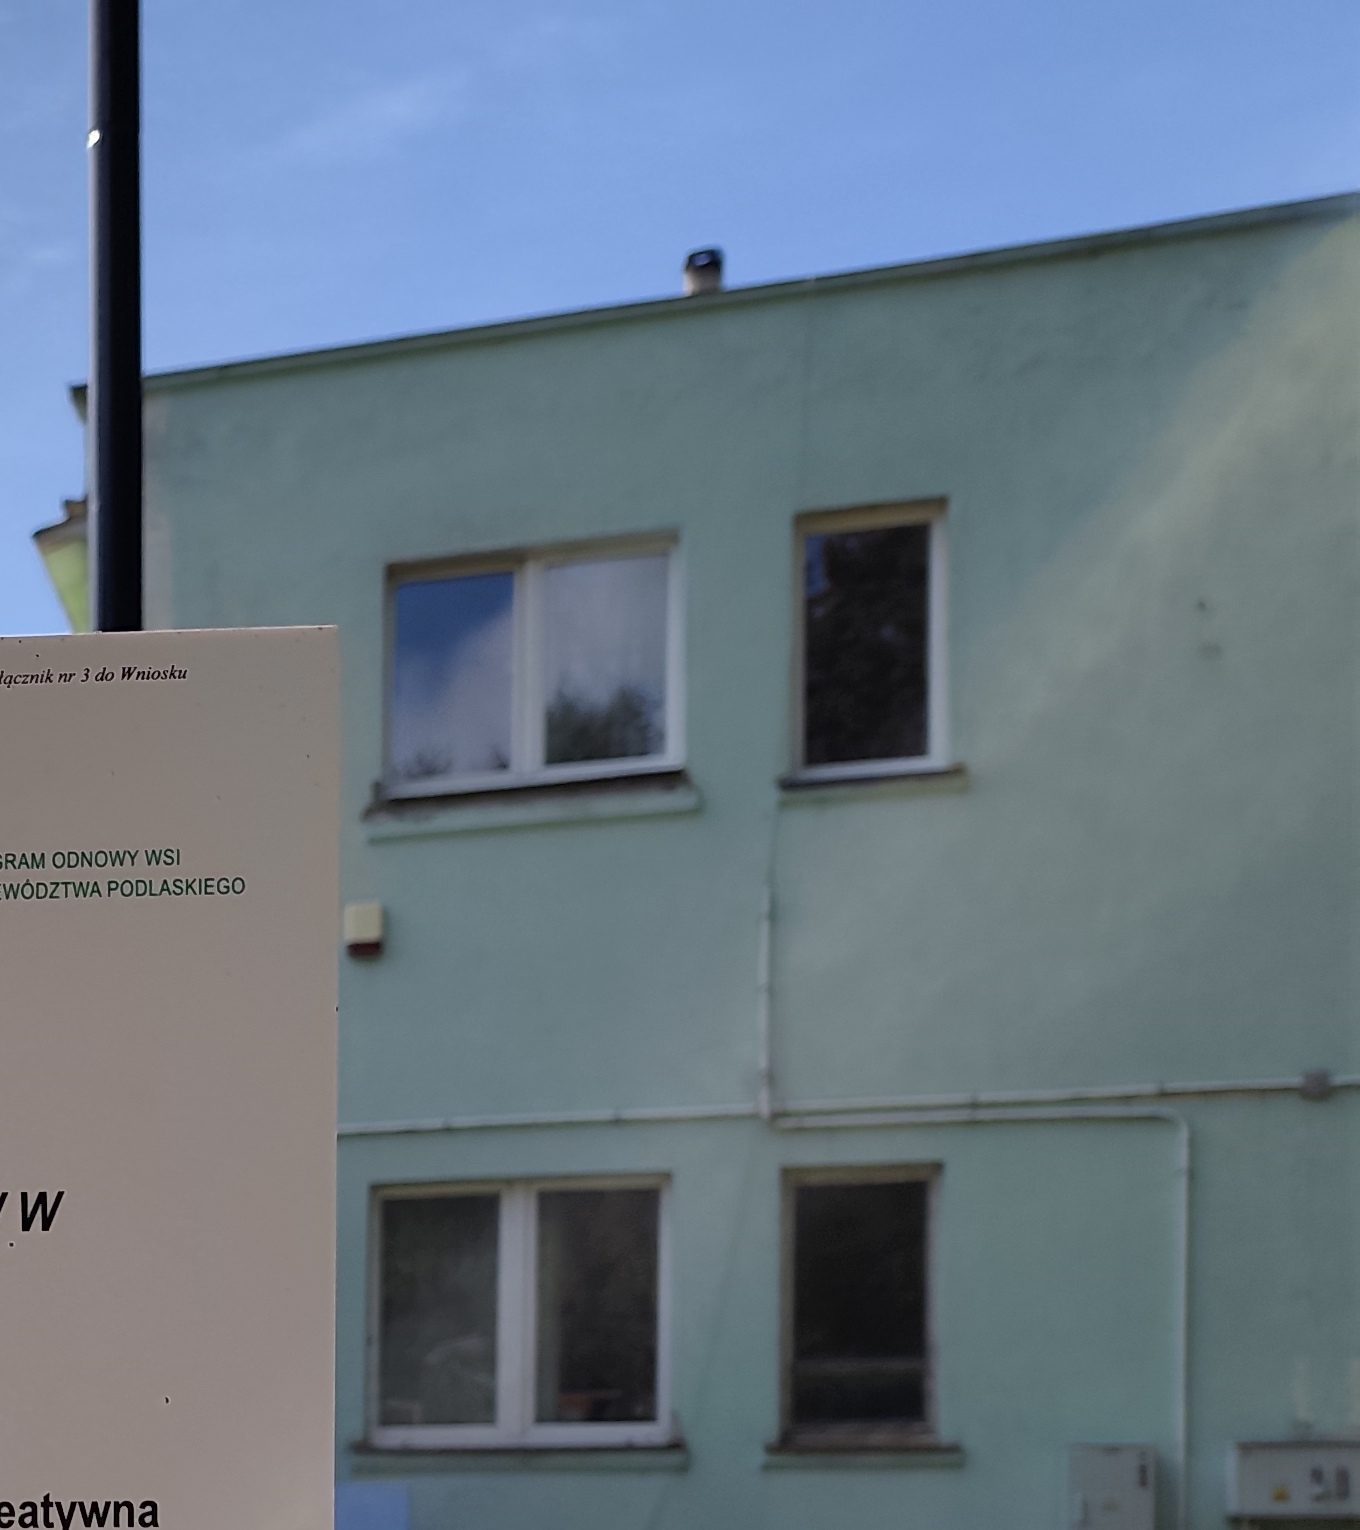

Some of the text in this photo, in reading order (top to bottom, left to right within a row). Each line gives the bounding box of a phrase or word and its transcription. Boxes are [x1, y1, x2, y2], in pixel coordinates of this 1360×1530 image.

[58, 673, 76, 683] nr
[81, 668, 90, 682] 3
[95, 667, 114, 682] do
[121, 665, 188, 681] Wniosku
[52, 850, 139, 868] ODNOWY
[145, 849, 180, 866] WSI
[107, 877, 245, 897] PODLASKIEGO
[21, 1191, 65, 1232] W
